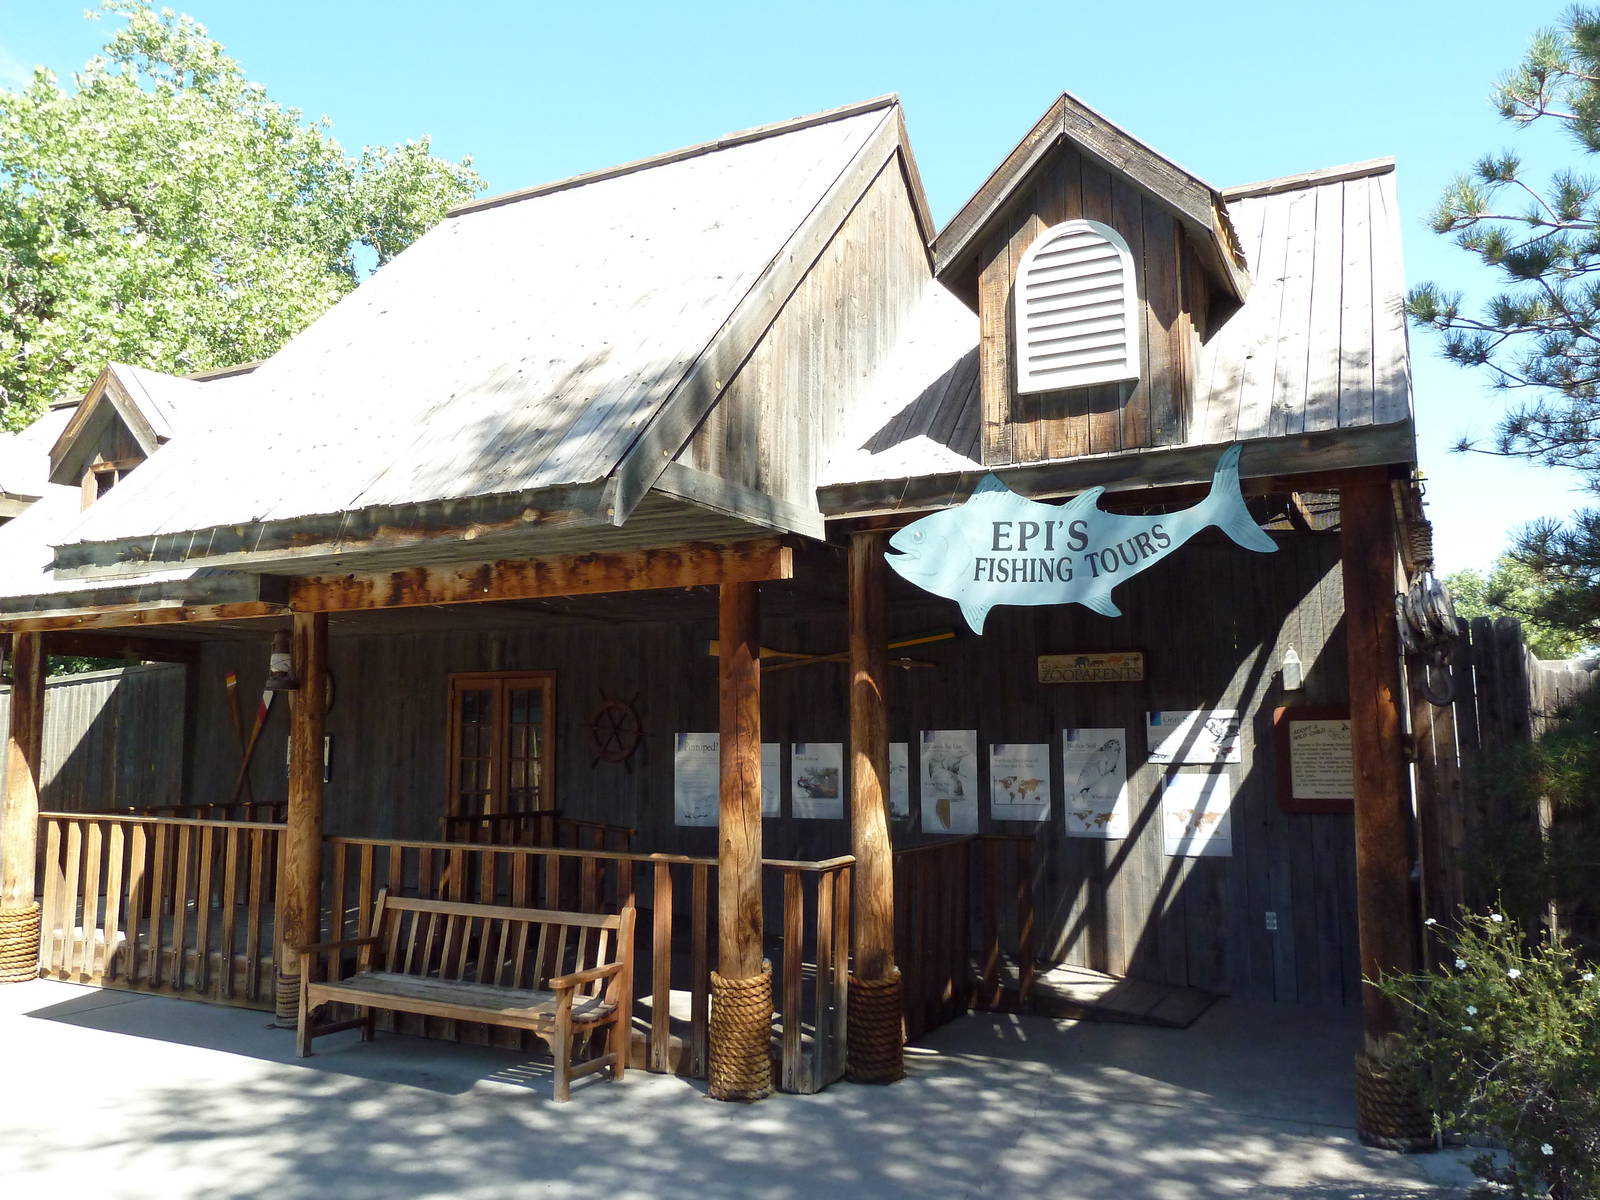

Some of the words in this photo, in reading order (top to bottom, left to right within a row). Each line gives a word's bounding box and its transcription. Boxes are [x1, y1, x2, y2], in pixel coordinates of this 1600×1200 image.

[973, 557, 1073, 583] FISHING
[1084, 524, 1171, 578] TOURS
[991, 519, 1089, 552] EPI'S
